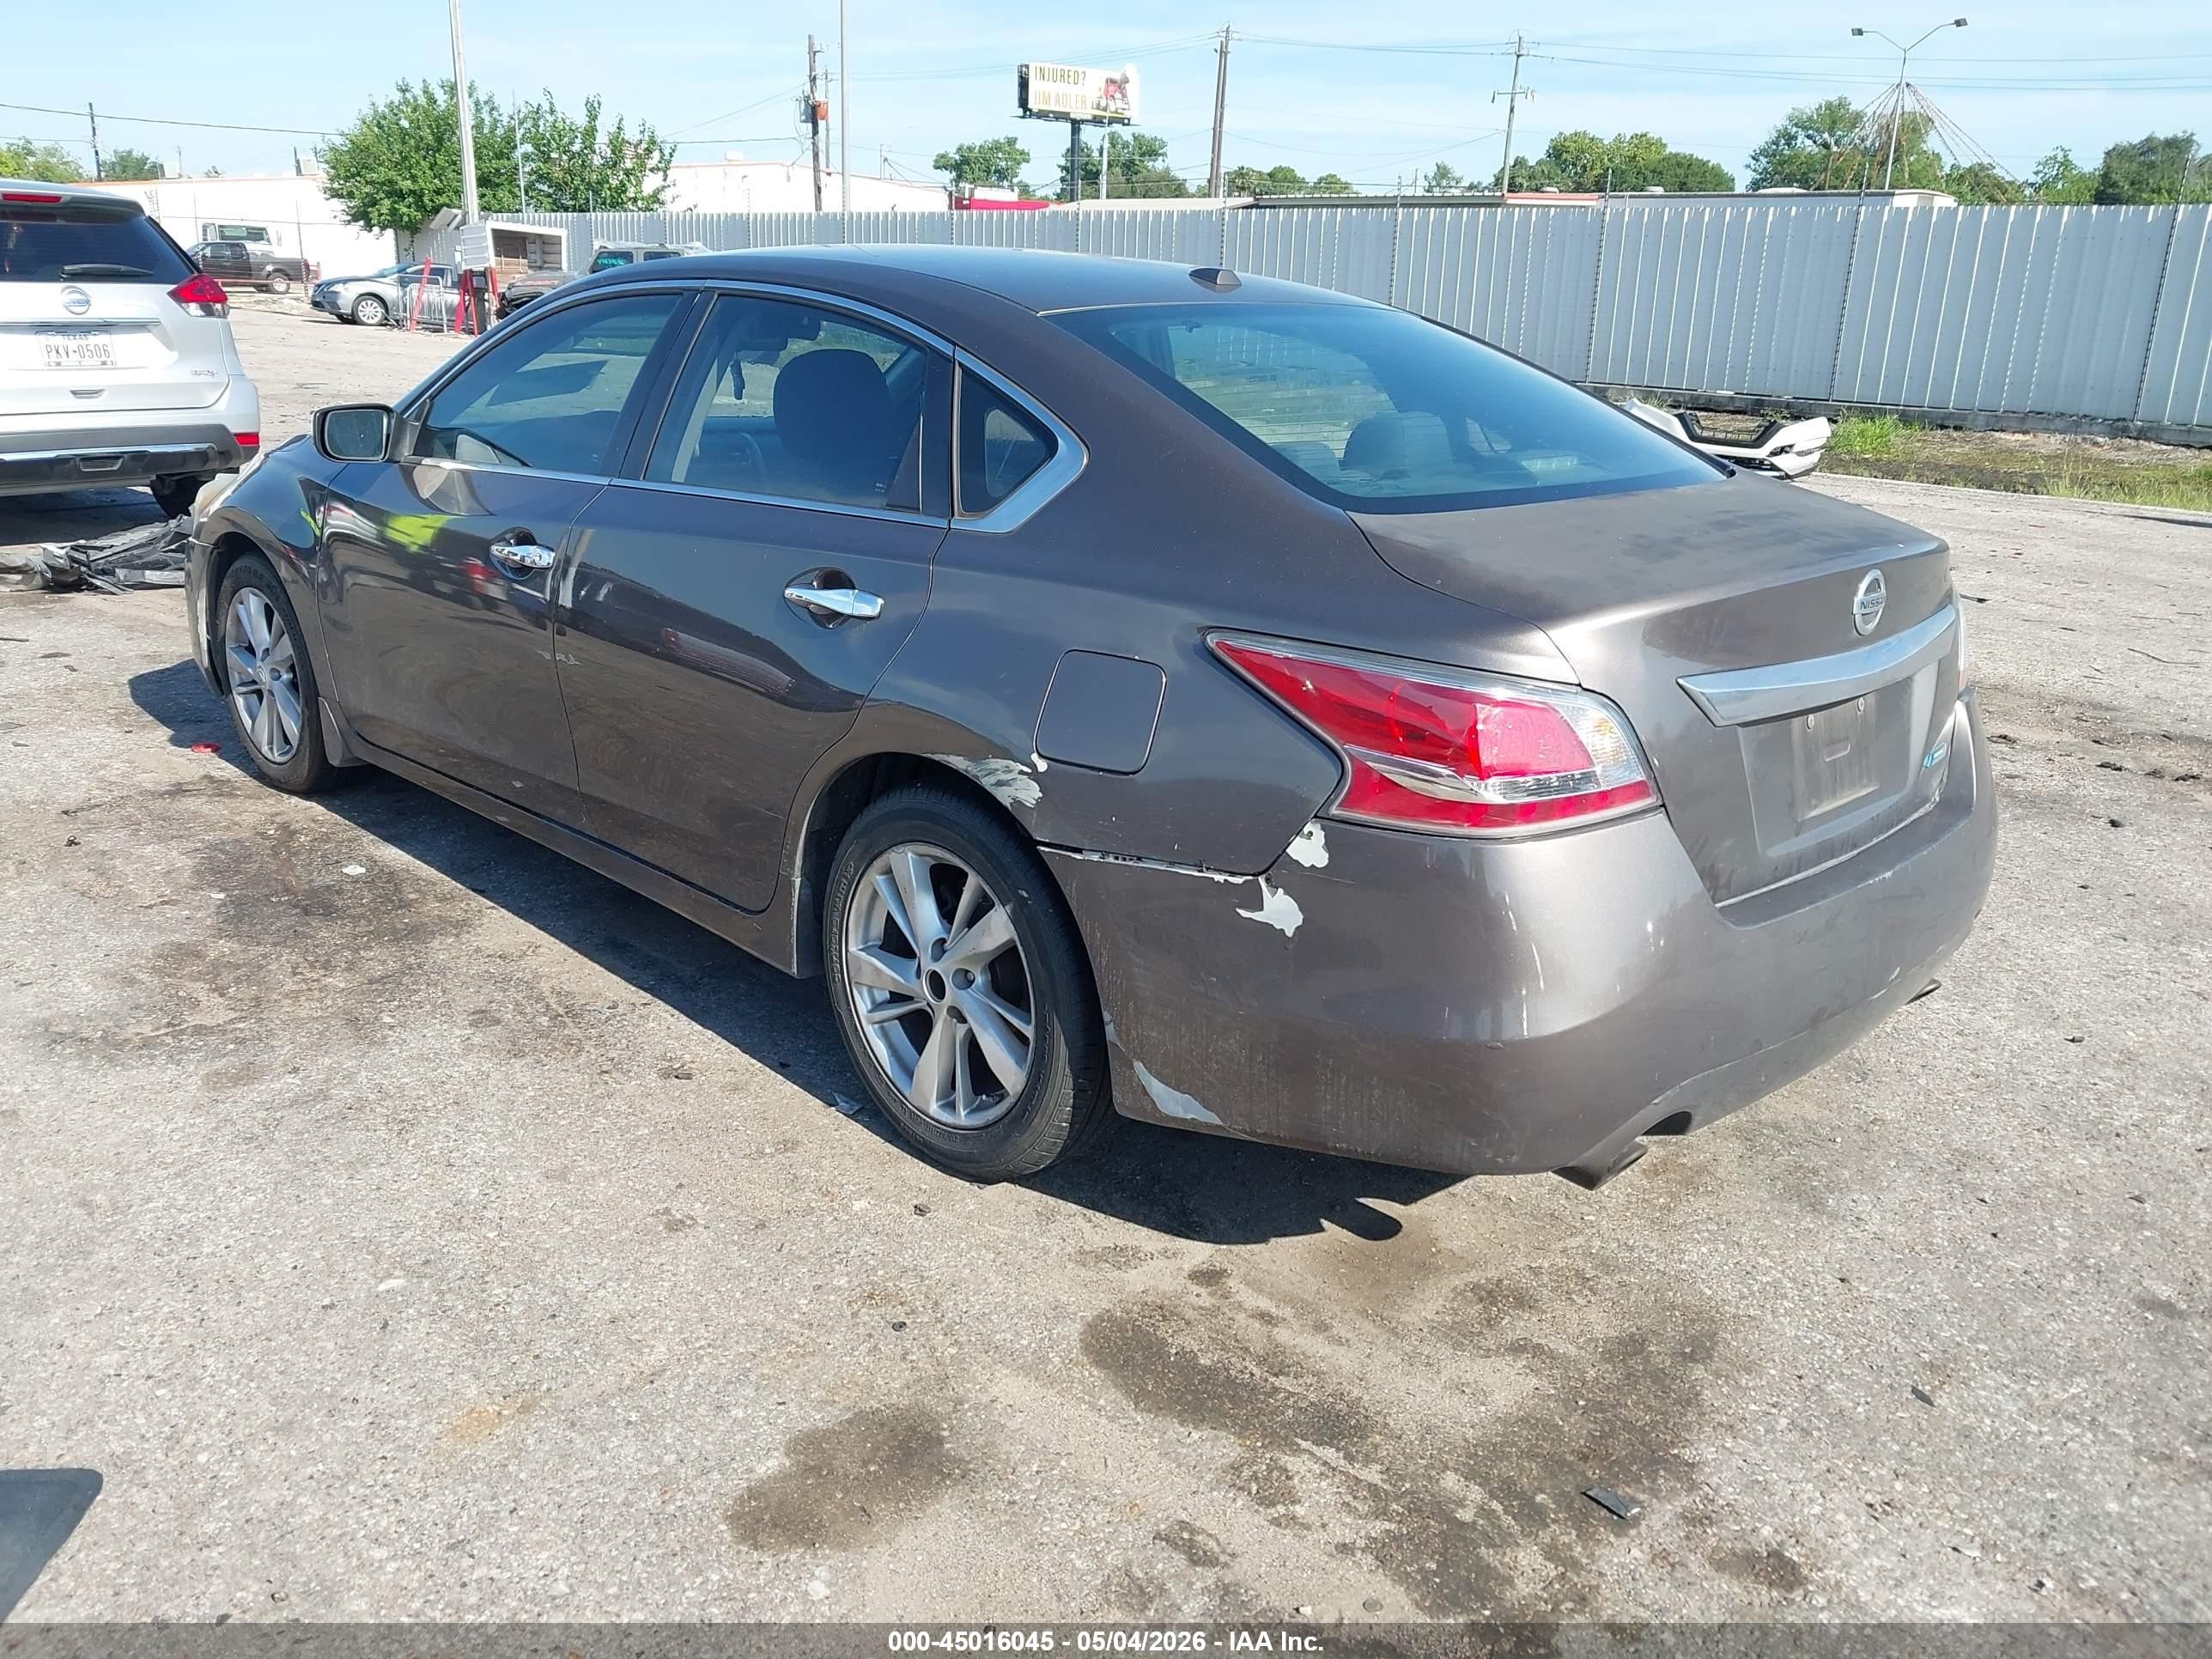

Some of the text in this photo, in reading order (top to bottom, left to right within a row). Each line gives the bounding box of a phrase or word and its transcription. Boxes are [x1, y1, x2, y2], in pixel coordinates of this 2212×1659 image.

[1035, 65, 1086, 86] INJURED?
[1033, 89, 1087, 110] JIM ADLER
[45, 343, 111, 359] PKV-0506
[1860, 596, 1885, 611] NISSA
